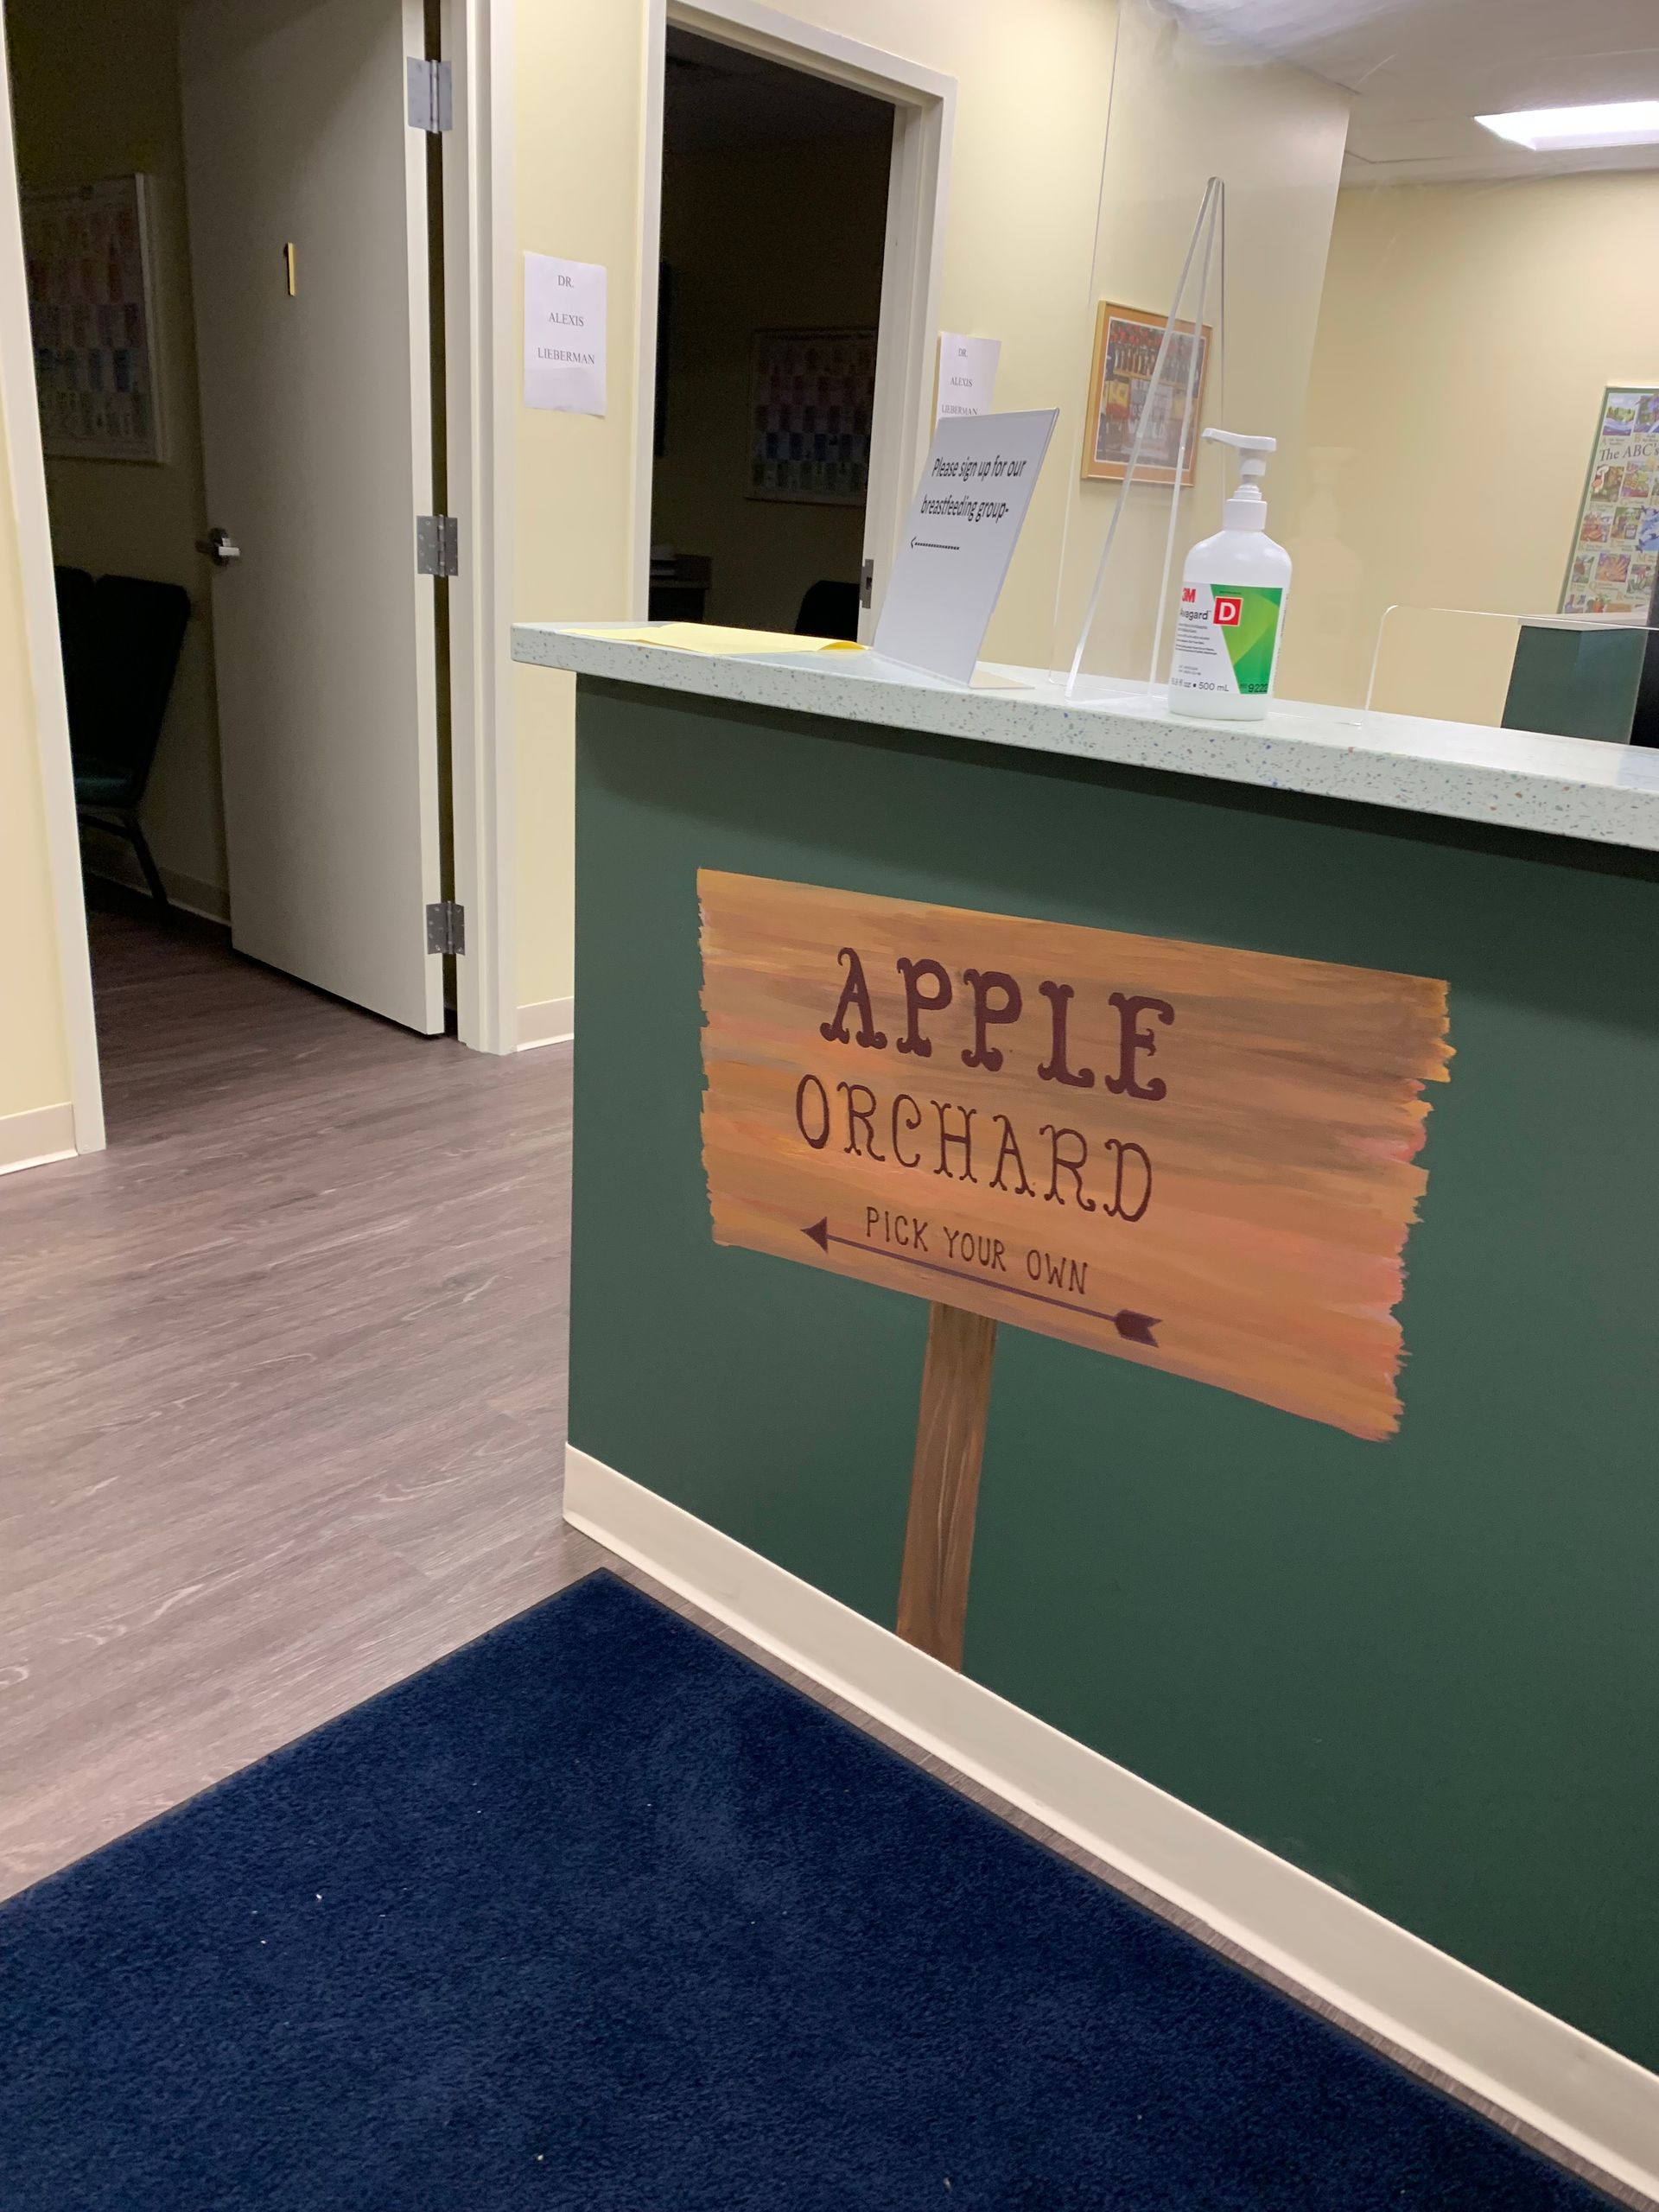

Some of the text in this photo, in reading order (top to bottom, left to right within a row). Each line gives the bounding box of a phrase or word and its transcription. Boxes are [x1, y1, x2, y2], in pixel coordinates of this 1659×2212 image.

[557, 275, 575, 288] DR.
[549, 312, 584, 327] ALEXIS
[537, 347, 595, 365] LIEBERMAN
[950, 377, 973, 388] ALEXIS
[941, 404, 978, 416] LIEBERMAN
[1599, 448, 1620, 462] The
[931, 454, 1027, 482] Please sign up for our
[920, 494, 978, 522] breastfeeding
[1182, 588, 1197, 603] 3M
[1198, 681, 1215, 691] 500
[1216, 683, 1230, 692] mL
[820, 947, 1175, 1102] APPLE
[795, 1073, 1153, 1223] ORCHARD
[866, 1205, 1088, 1295] PICK YOUR OWN
